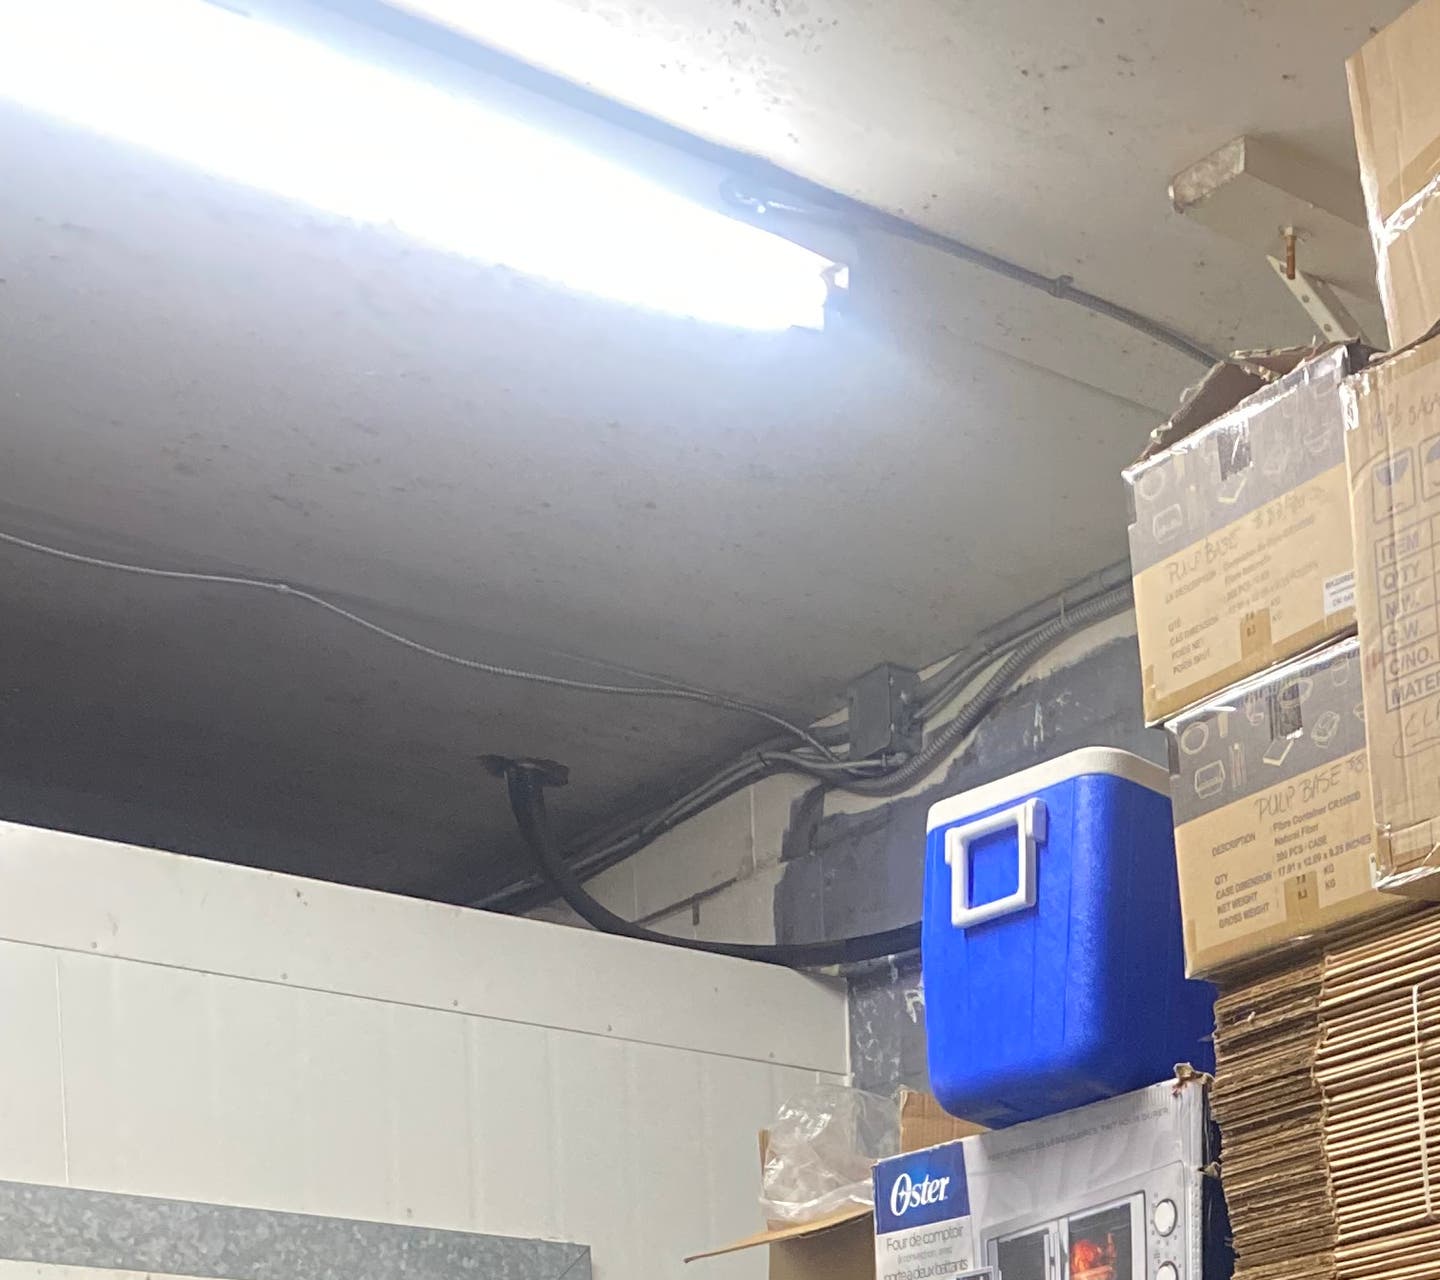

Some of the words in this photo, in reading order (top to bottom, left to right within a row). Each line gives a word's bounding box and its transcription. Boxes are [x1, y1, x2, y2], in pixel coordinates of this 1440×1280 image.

[1211, 832, 1256, 857] DESCRIPTION
[1214, 873, 1229, 886] QTY
[890, 1172, 951, 1217] Oster
